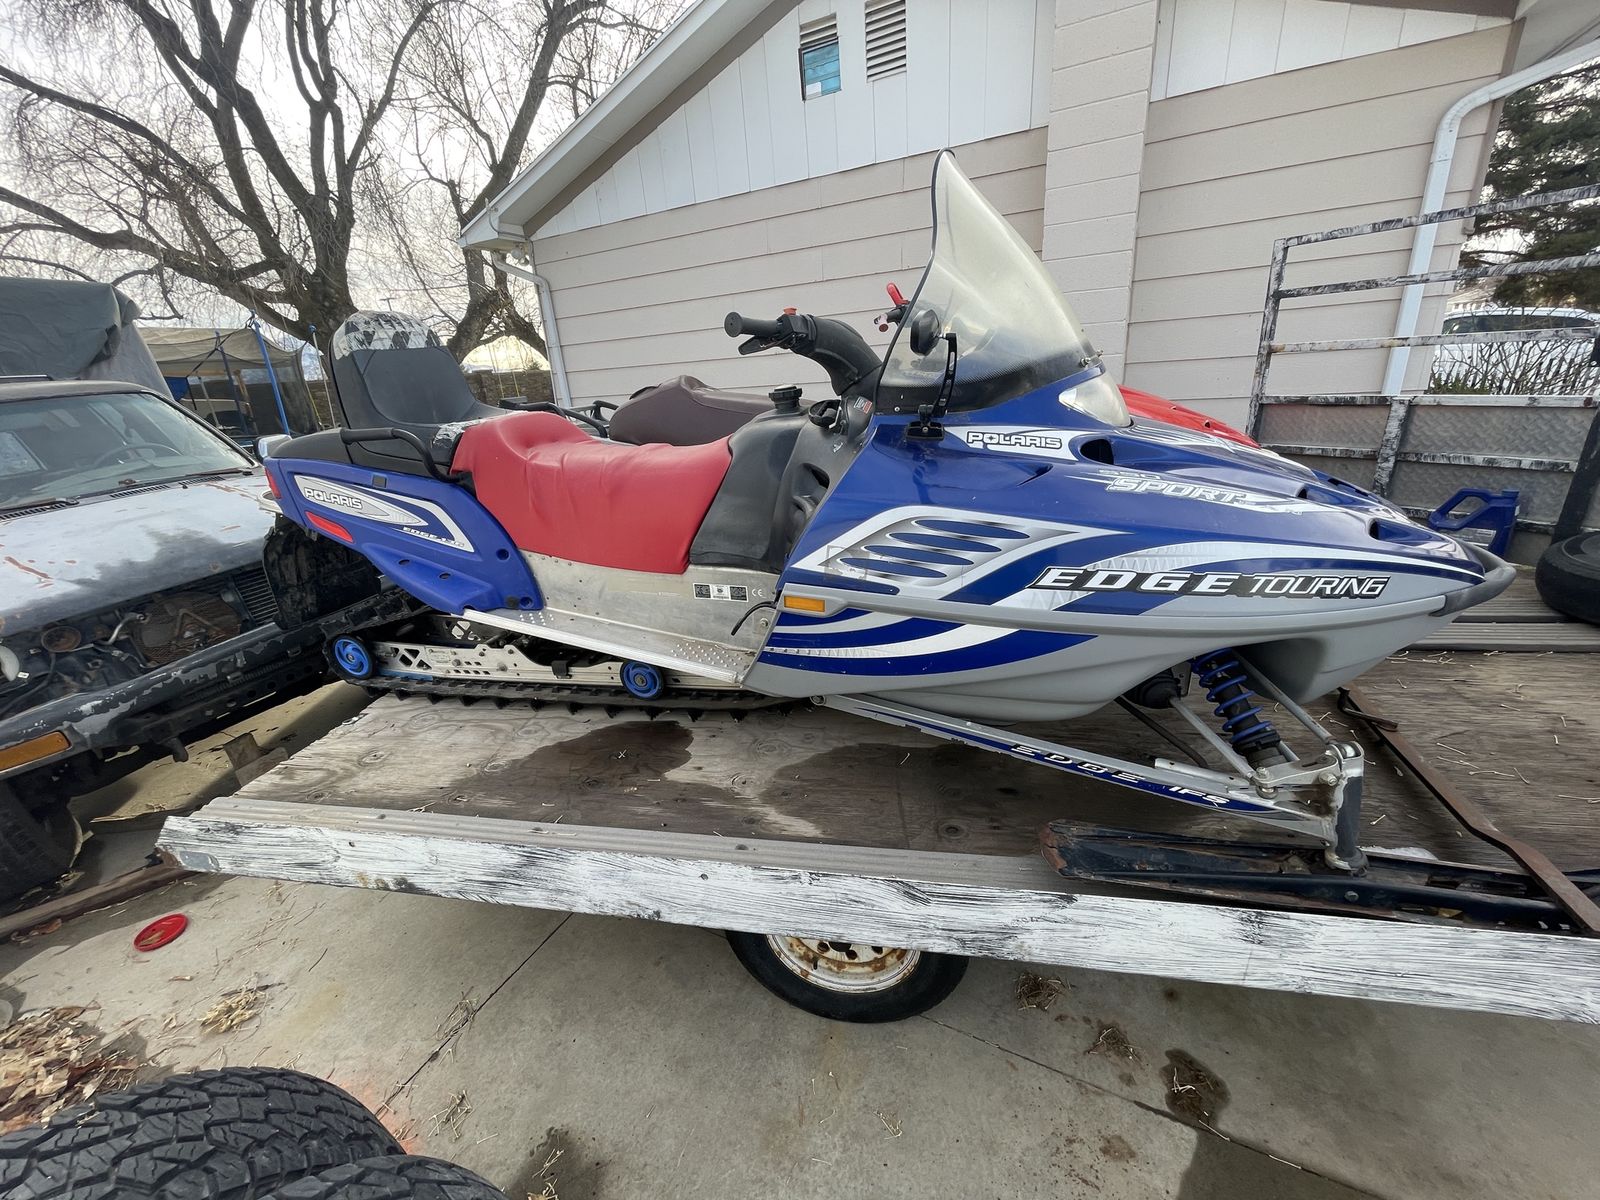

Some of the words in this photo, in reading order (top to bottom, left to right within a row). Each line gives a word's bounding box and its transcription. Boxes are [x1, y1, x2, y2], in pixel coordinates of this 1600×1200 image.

[967, 432, 1062, 449] POLARIS
[304, 487, 364, 510] POLARIS
[1107, 477, 1252, 504] SPORT
[403, 526, 438, 540] EDGE
[1042, 568, 1243, 594] EDGE
[1249, 576, 1388, 596] TOURING
[1011, 745, 1147, 783] EDGE
[1168, 785, 1230, 805] IFS
